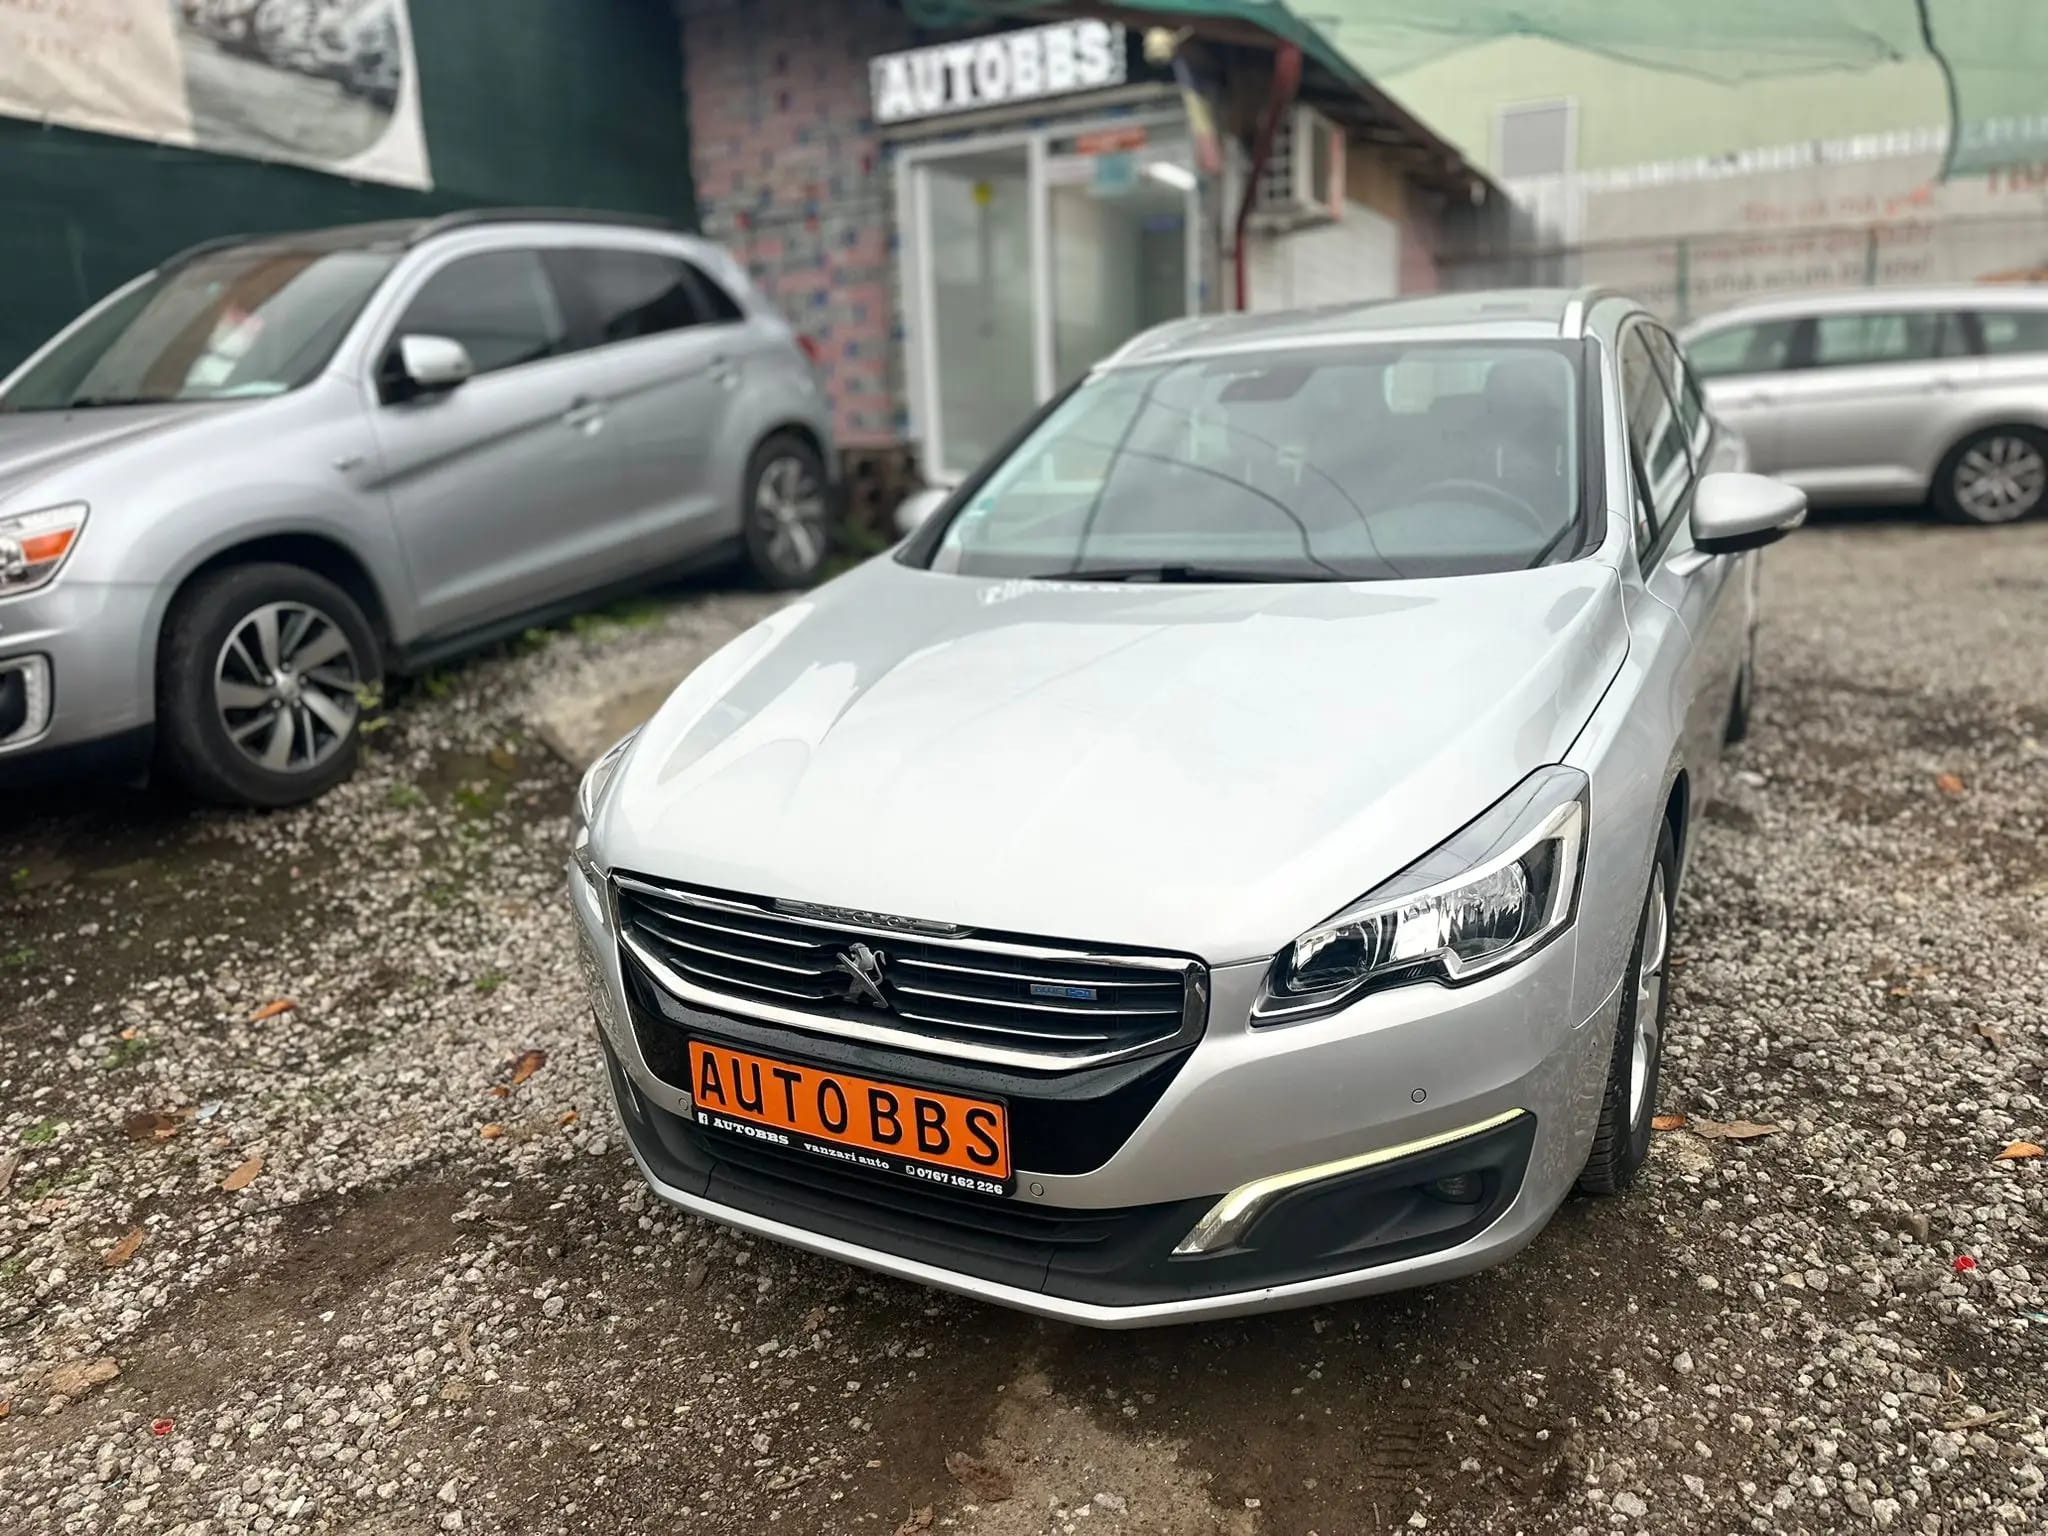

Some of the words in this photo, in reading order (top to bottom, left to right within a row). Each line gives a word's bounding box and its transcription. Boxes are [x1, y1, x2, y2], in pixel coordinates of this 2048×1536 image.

[876, 18, 1112, 122] AUTOBBS
[713, 1117, 790, 1146] AUTOBBS
[803, 1142, 857, 1163] vanzari
[858, 1155, 890, 1170] auto
[916, 1167, 949, 1184] 0767
[951, 1174, 976, 1190] 162
[976, 1181, 1004, 1196] 226
